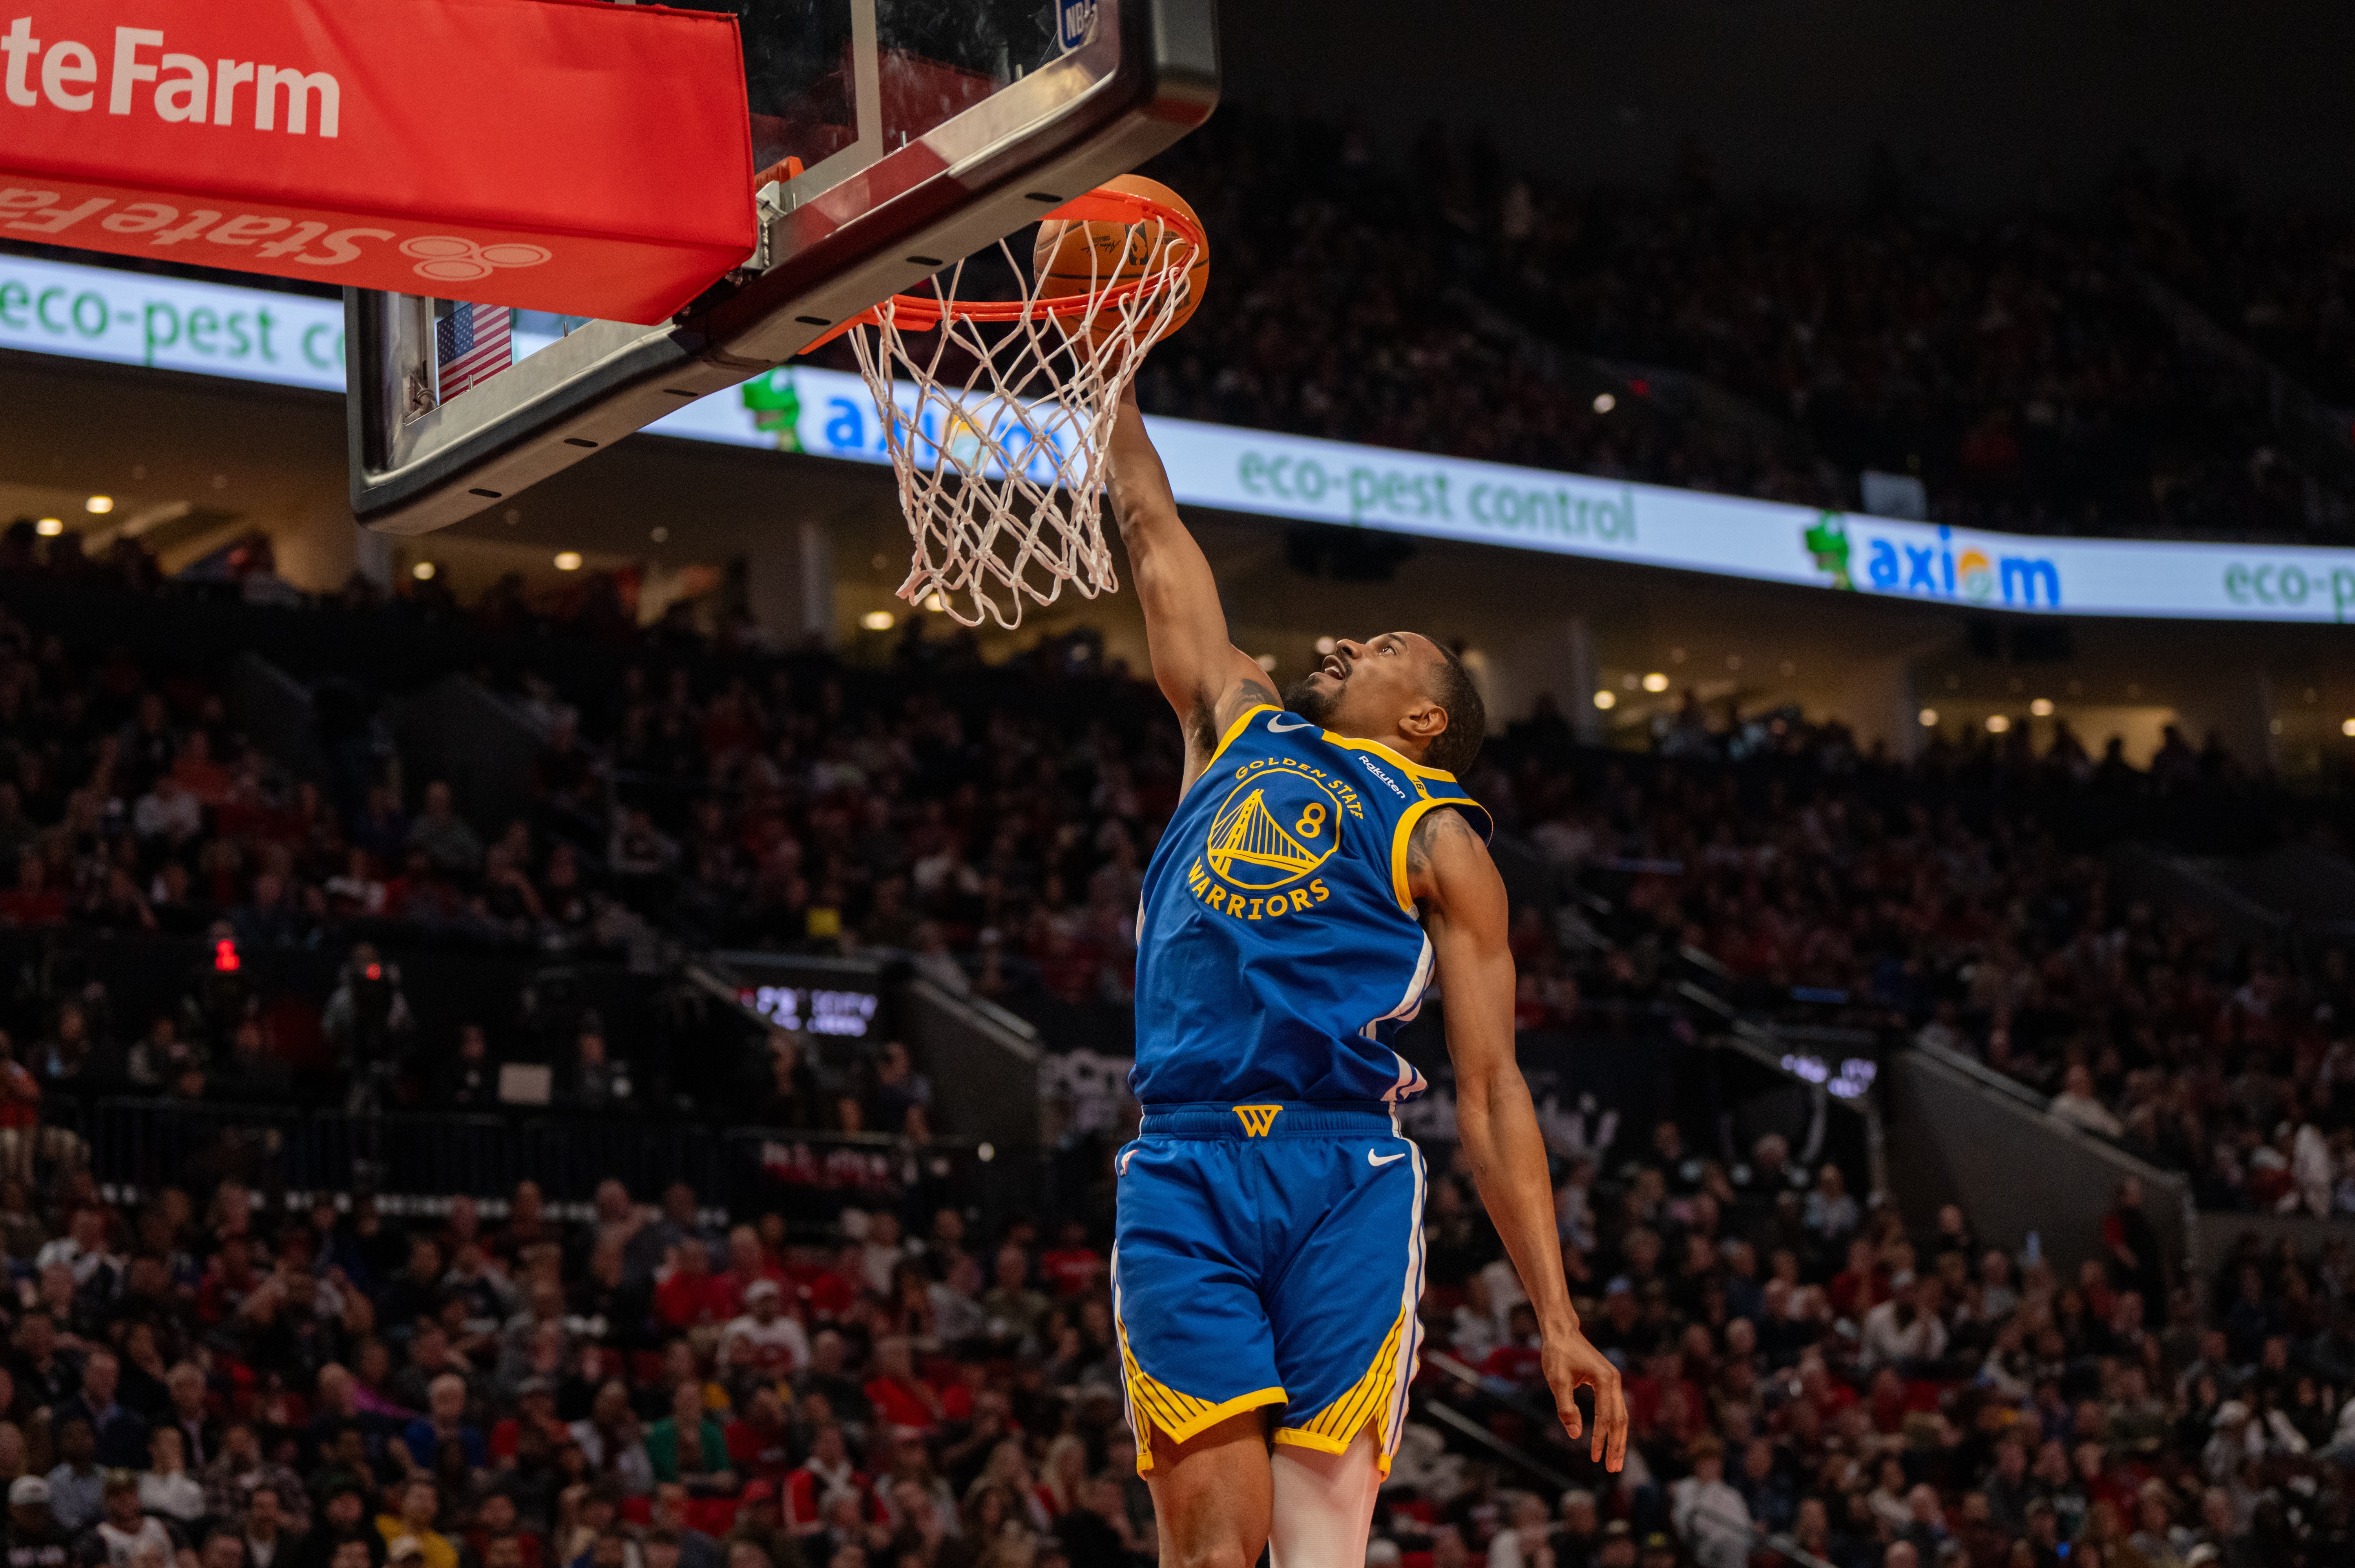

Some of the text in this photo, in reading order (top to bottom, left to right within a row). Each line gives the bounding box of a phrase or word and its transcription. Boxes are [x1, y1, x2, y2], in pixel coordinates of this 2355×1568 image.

[0, 280, 277, 367] eco-pest
[1239, 451, 1637, 542] eco-pest control
[1869, 525, 2060, 606] axiom
[1236, 757, 1364, 820] GOLDEN STATE
[1358, 755, 1406, 799] Rakuten
[1296, 802, 1326, 838] 8
[1188, 856, 1330, 920] WARRIORS
